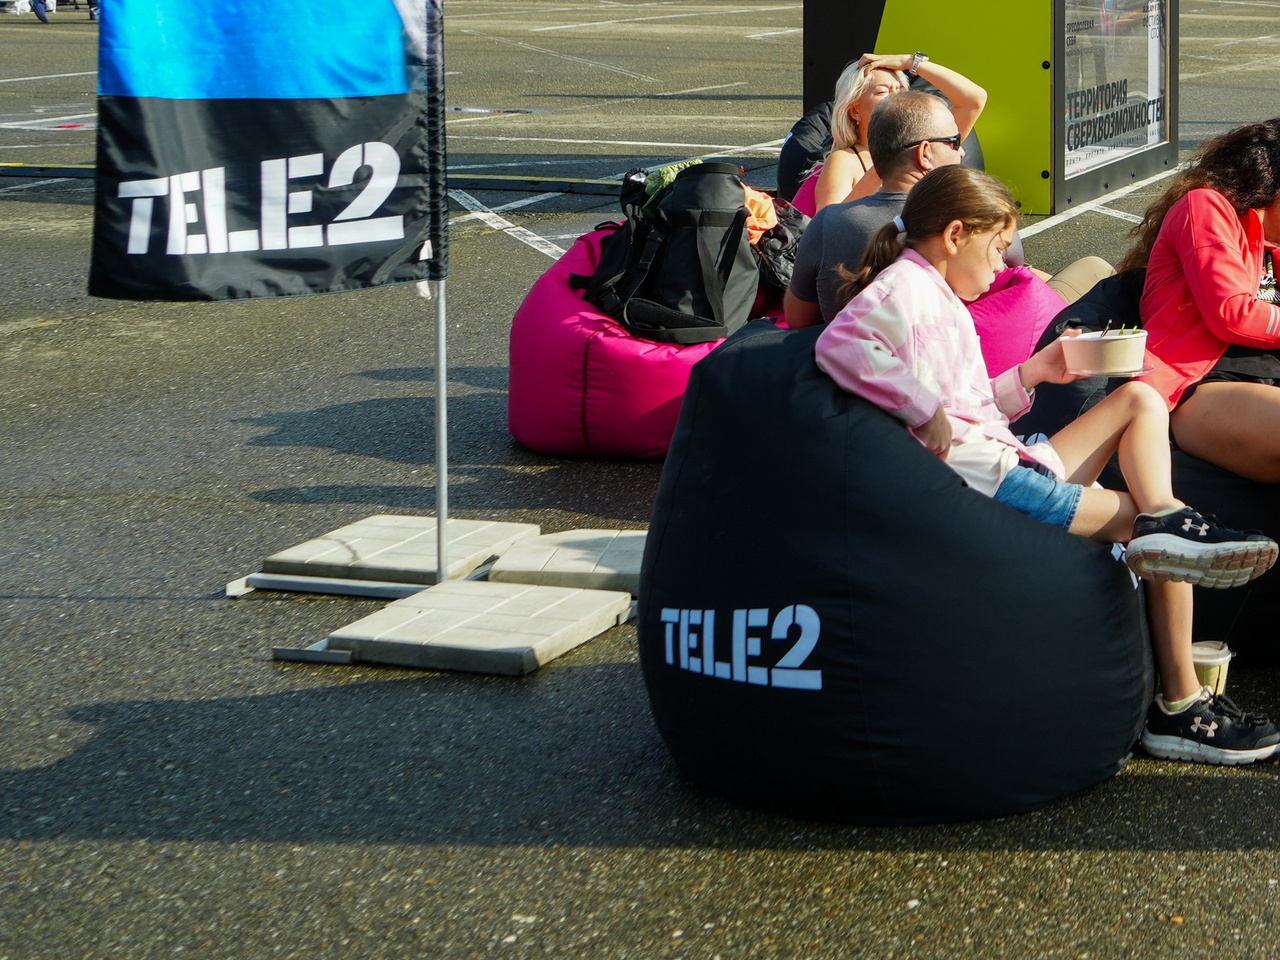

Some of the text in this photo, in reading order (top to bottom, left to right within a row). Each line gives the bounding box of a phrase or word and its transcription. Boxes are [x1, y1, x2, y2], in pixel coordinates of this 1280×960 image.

[1066, 78, 1128, 120] ТЕРРИТОРИЯ
[1066, 88, 1166, 152] СВЕРХВОЗМОЖНОСТЕЙ
[117, 140, 405, 255] TELE2
[660, 604, 823, 690] TELE2
